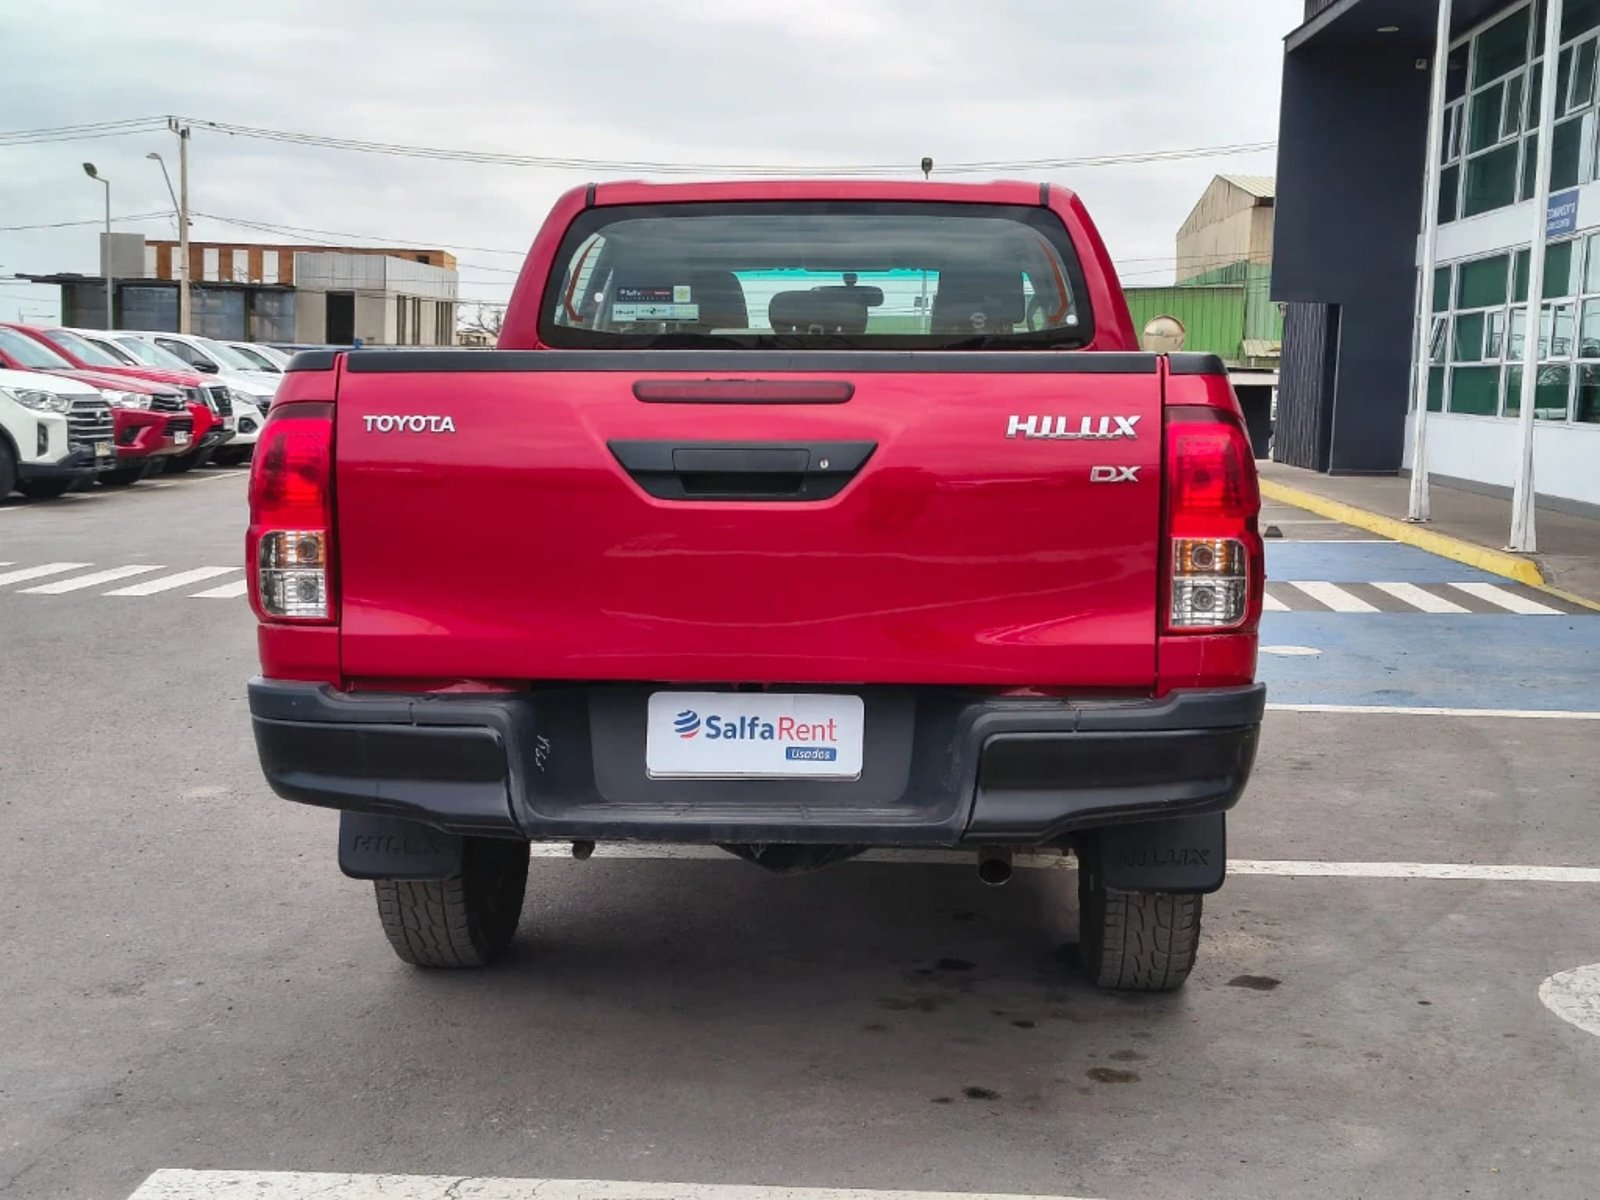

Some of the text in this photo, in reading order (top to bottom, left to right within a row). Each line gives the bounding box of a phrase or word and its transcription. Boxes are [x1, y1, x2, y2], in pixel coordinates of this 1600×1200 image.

[362, 414, 456, 432] TOYOTA
[1006, 415, 1141, 440] HILUX
[1090, 465, 1141, 482] DX
[705, 714, 837, 742] SalfaRent
[791, 749, 831, 760] Usados
